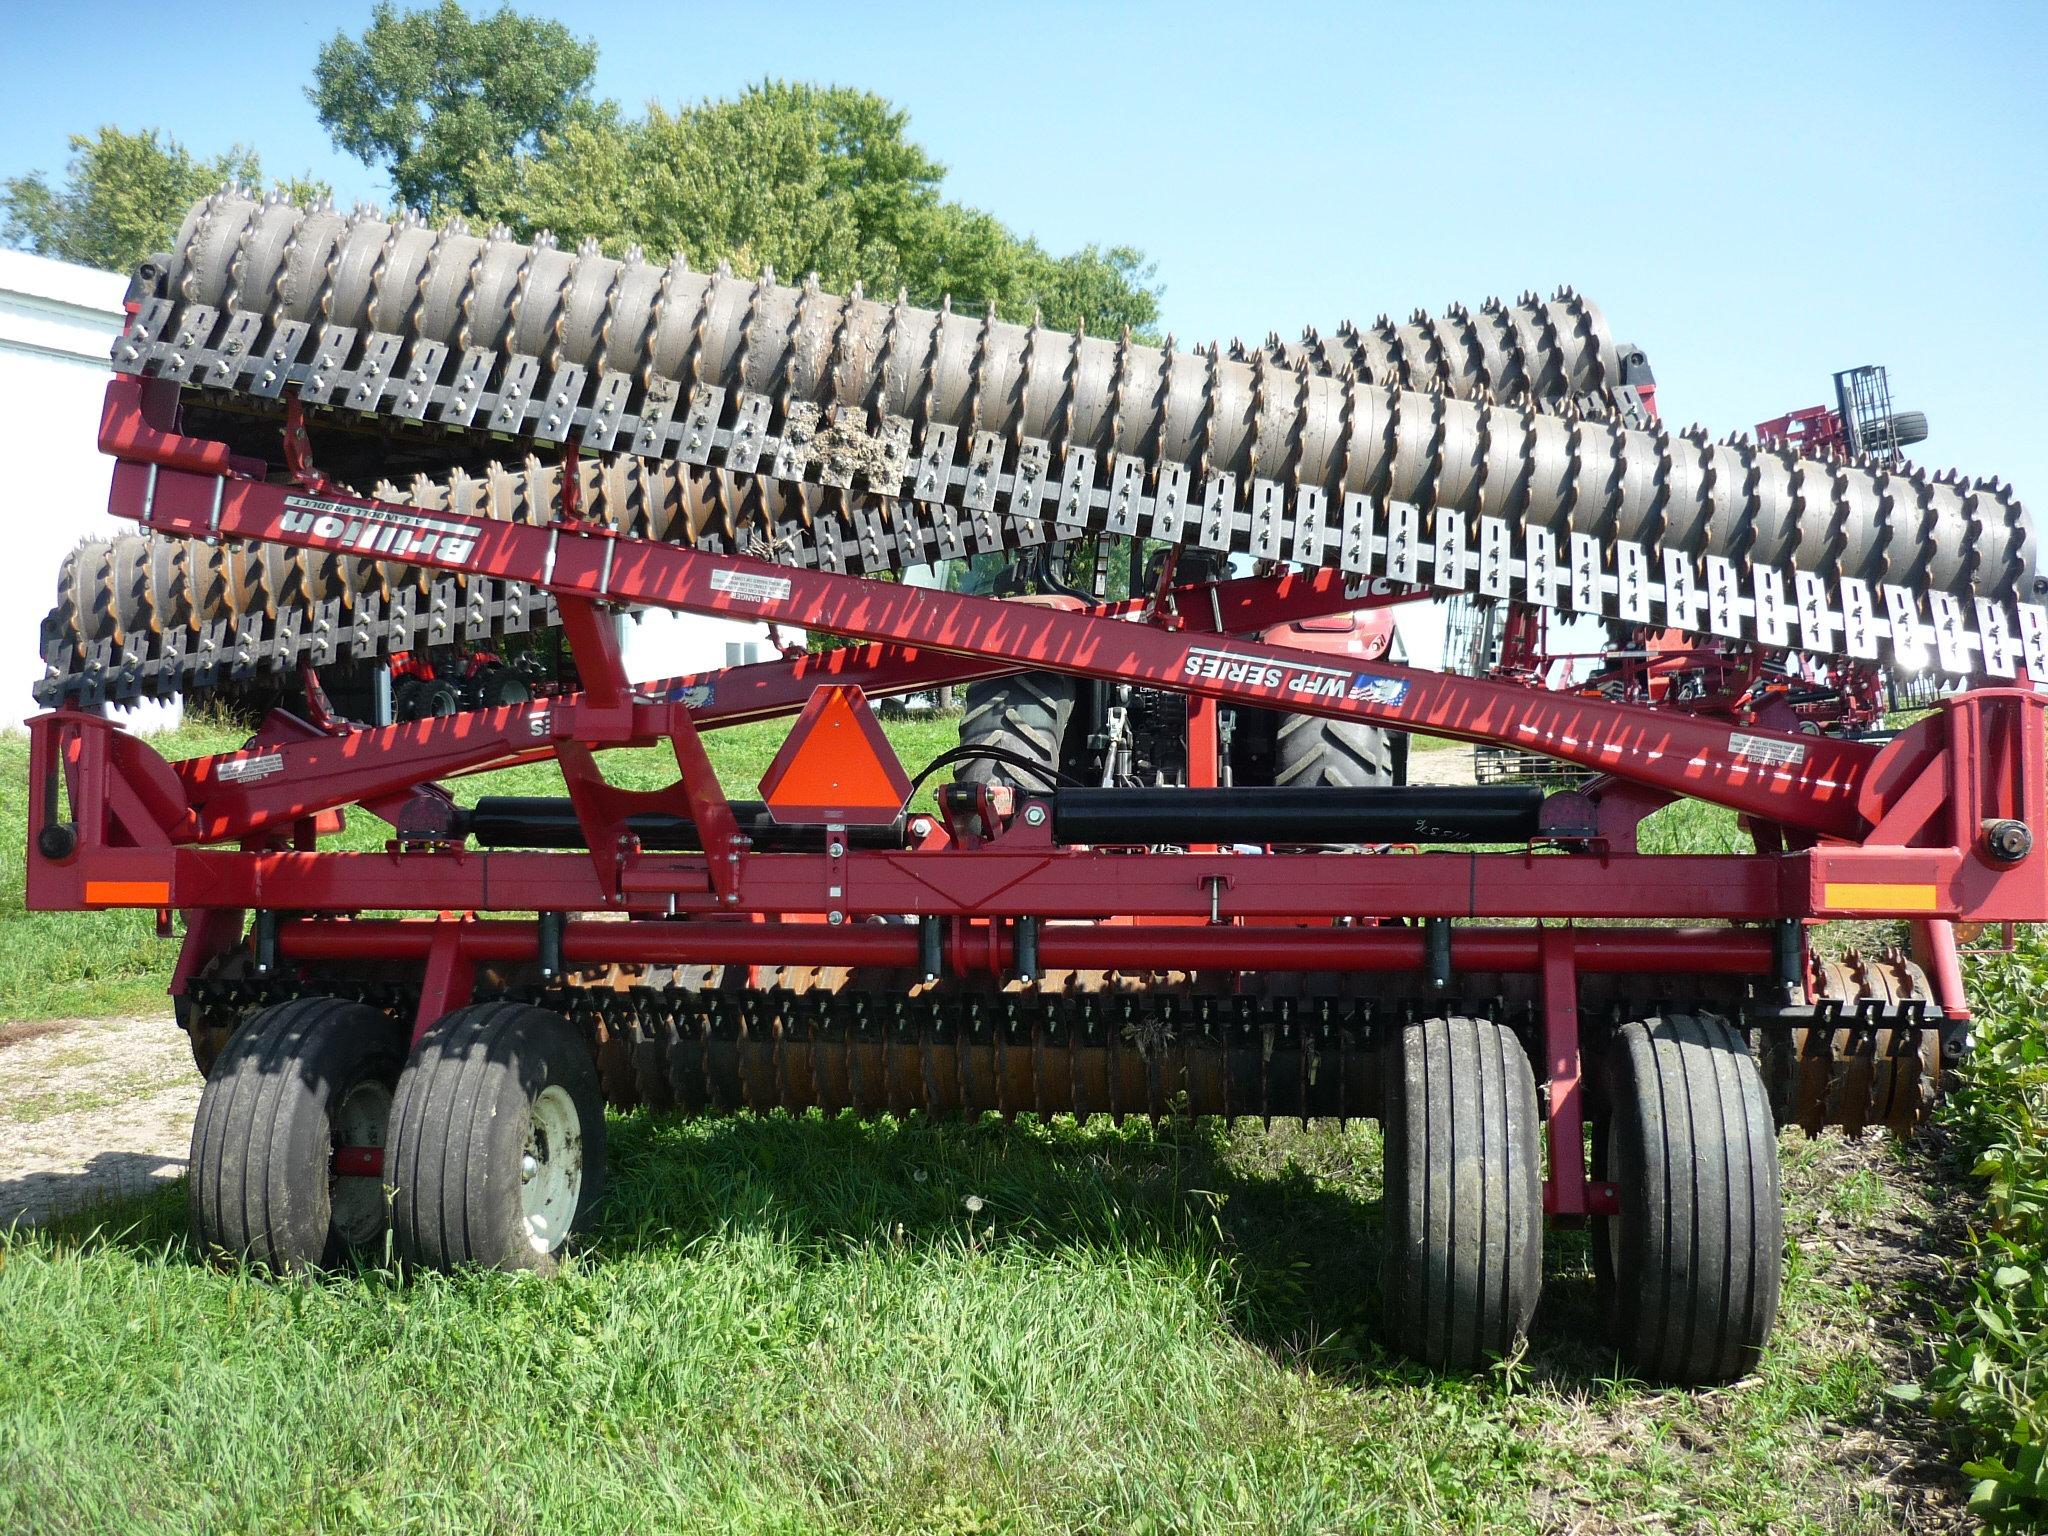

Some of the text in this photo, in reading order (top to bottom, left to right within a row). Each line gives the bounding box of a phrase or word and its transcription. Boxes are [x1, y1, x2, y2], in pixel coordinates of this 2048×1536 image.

[294, 498, 351, 514] PRODUCT
[354, 507, 411, 524] LANDOLL
[280, 510, 475, 564] Brillion
[730, 592, 761, 603] DANGER
[1184, 655, 1346, 698] WFP SERIES
[1747, 755, 1776, 766] DANGER
